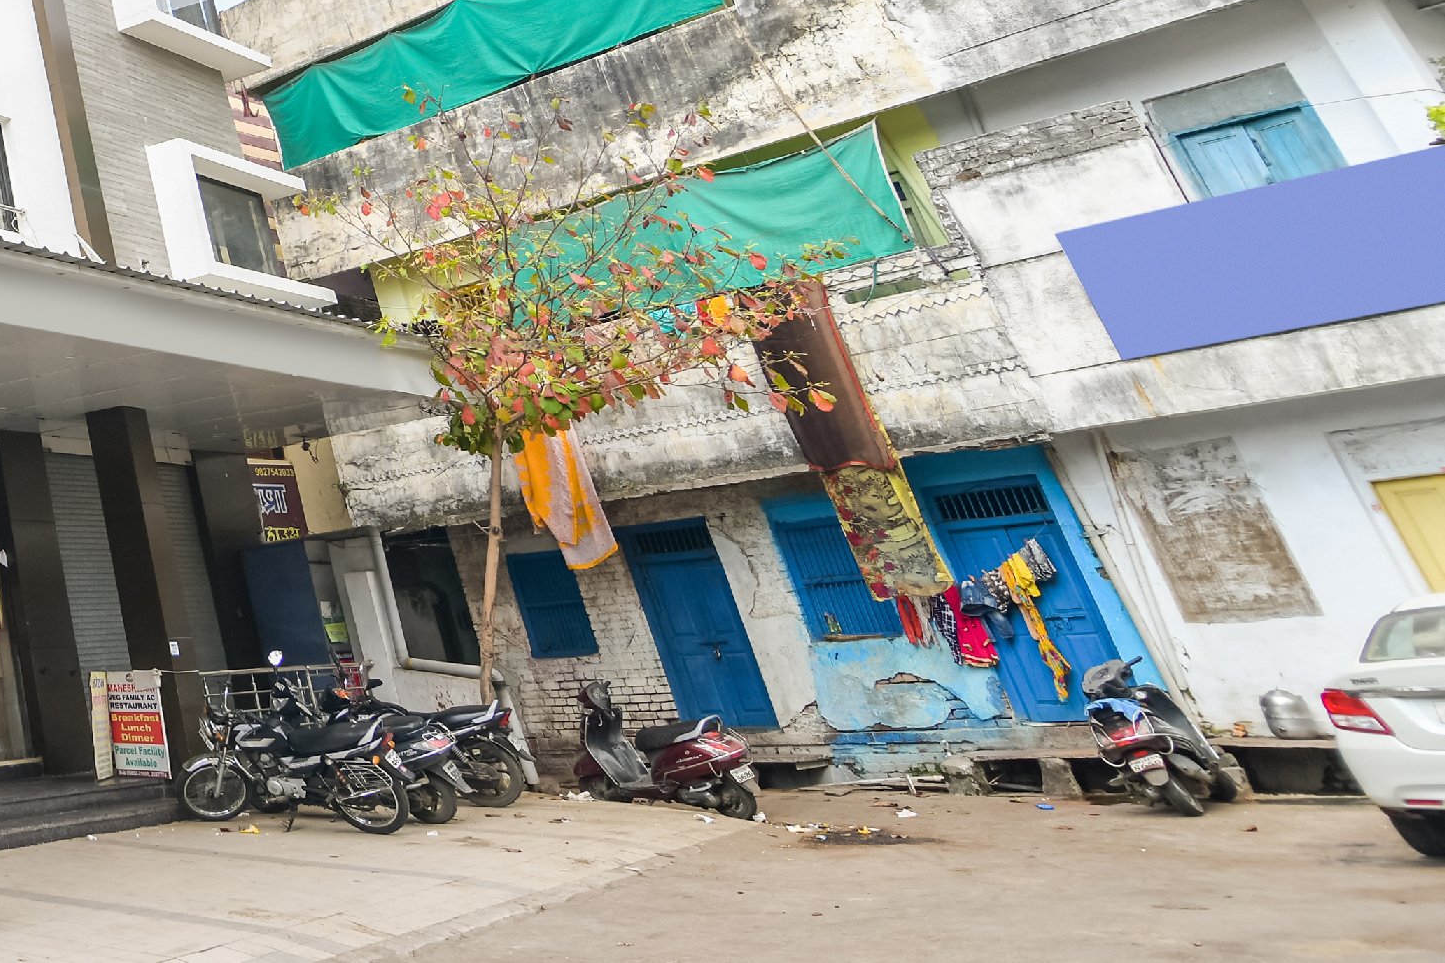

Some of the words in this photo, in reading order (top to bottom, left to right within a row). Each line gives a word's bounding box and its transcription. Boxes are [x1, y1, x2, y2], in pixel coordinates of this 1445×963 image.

[111, 713, 160, 722] Breakfast
[120, 723, 152, 732] Lunch
[120, 733, 155, 742] Dinner
[114, 745, 137, 755] Parcel
[139, 746, 165, 758] Facility
[125, 757, 157, 767] Available
